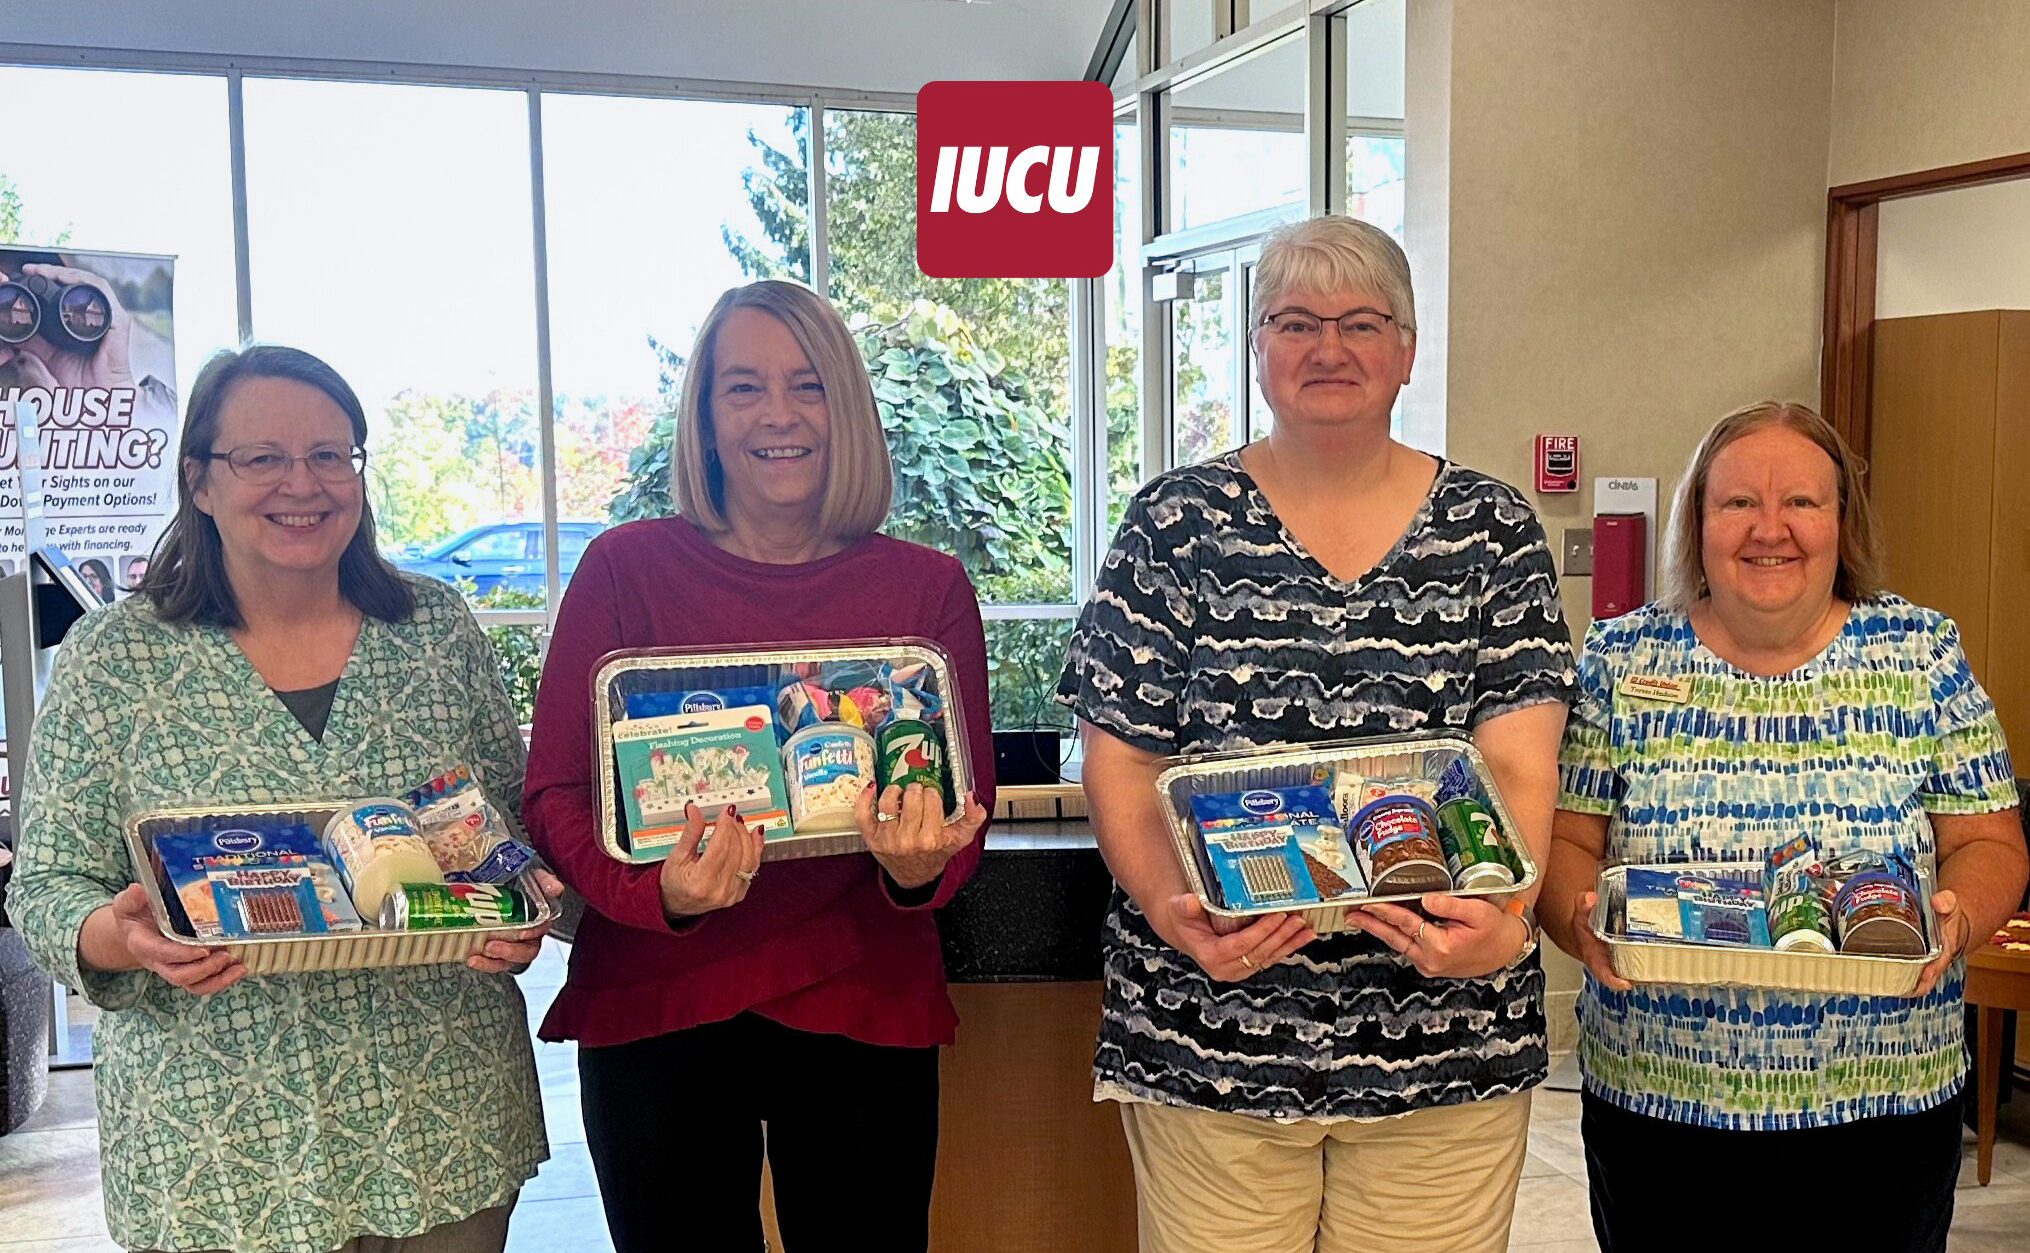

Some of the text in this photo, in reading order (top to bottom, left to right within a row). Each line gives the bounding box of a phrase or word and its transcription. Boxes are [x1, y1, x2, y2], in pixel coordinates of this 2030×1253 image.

[0, 386, 136, 428] HOUSE
[0, 428, 168, 470] UTING?
[1546, 438, 1574, 450] FIRE
[0, 477, 13, 489] et
[50, 475, 91, 491] Sights
[93, 478, 110, 488] on
[113, 477, 136, 489] our
[0, 493, 158, 510] Do Payment Options!
[59, 524, 97, 536] Experts
[98, 524, 115, 534] are
[117, 524, 148, 537] ready
[59, 542, 81, 551] with
[649, 731, 742, 750] Flashing Decoration
[1375, 815, 1418, 831] Chocolate
[1377, 825, 1404, 839] Fudge
[217, 836, 259, 846] Pillsbury
